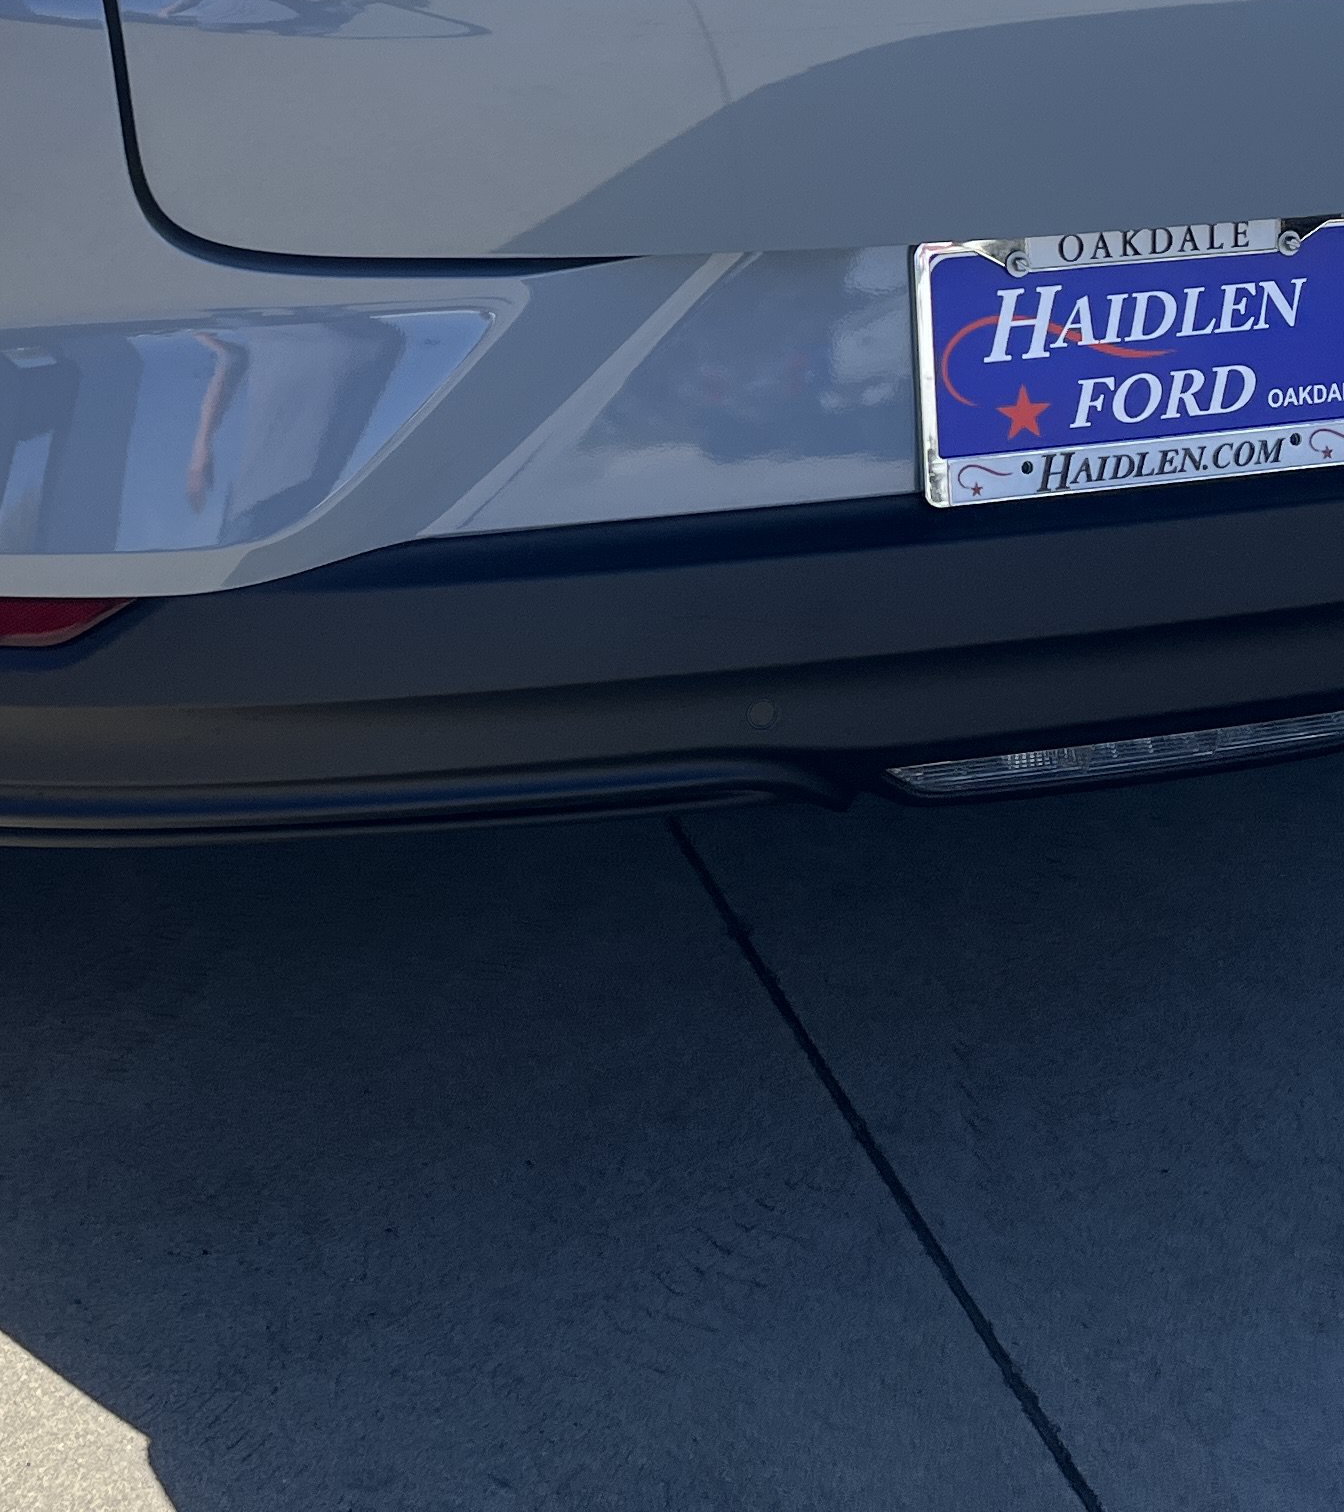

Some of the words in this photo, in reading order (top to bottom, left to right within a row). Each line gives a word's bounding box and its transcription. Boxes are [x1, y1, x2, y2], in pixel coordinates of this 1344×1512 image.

[1057, 220, 1251, 263] OAKDALE
[983, 277, 1308, 364] HAIDLEN
[1069, 364, 1257, 429] FORD
[1035, 437, 1286, 493] HAIDLEN.COM
